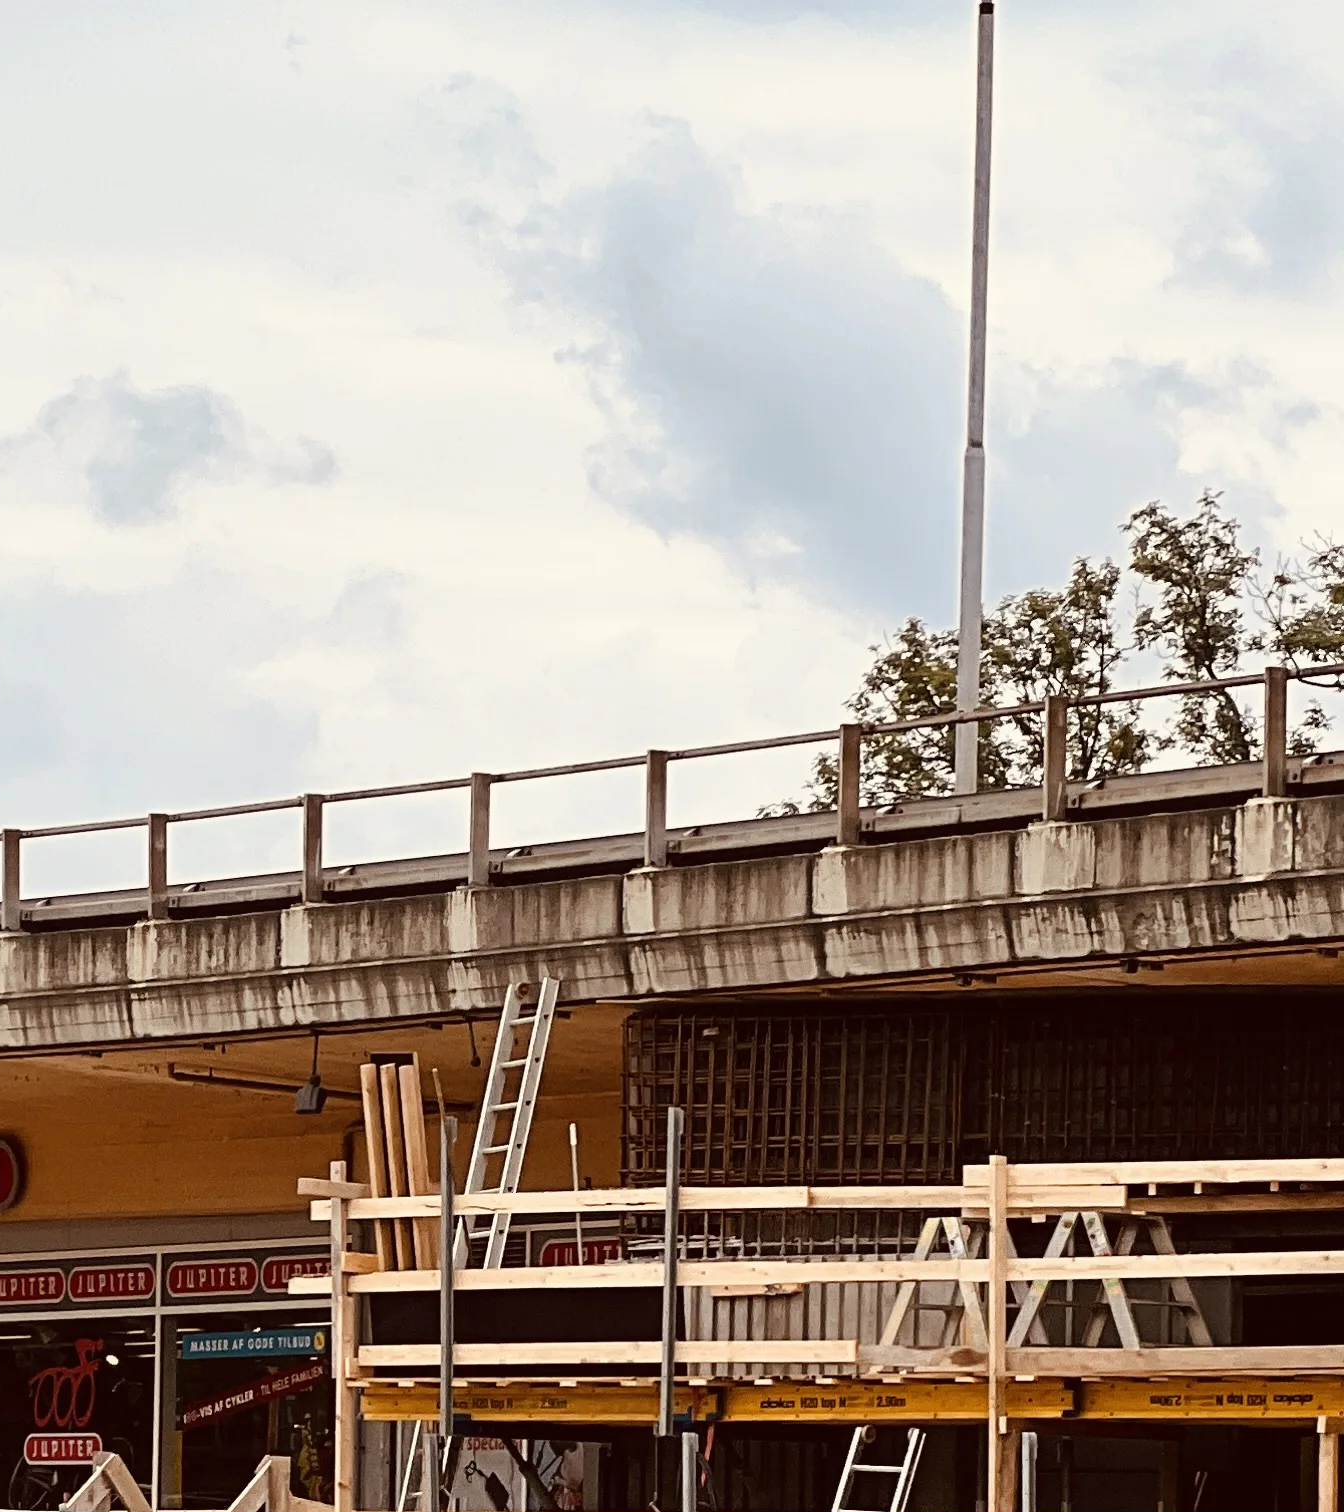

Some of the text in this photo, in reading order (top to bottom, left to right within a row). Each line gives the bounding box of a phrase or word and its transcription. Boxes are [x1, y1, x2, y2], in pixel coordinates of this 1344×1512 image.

[77, 1272, 146, 1293] JUPITER
[177, 1266, 248, 1288] JUPITER
[190, 1335, 311, 1352] MASSER AF GODE TILBUD
[214, 1400, 224, 1413] AF
[225, 1389, 254, 1409] CYKLER
[291, 1365, 324, 1385] FAMILIEN
[760, 1396, 795, 1409] doka
[800, 1396, 818, 1409] H20
[821, 1396, 837, 1411] top
[839, 1396, 846, 1408] N
[32, 1439, 93, 1458] JUPITER
